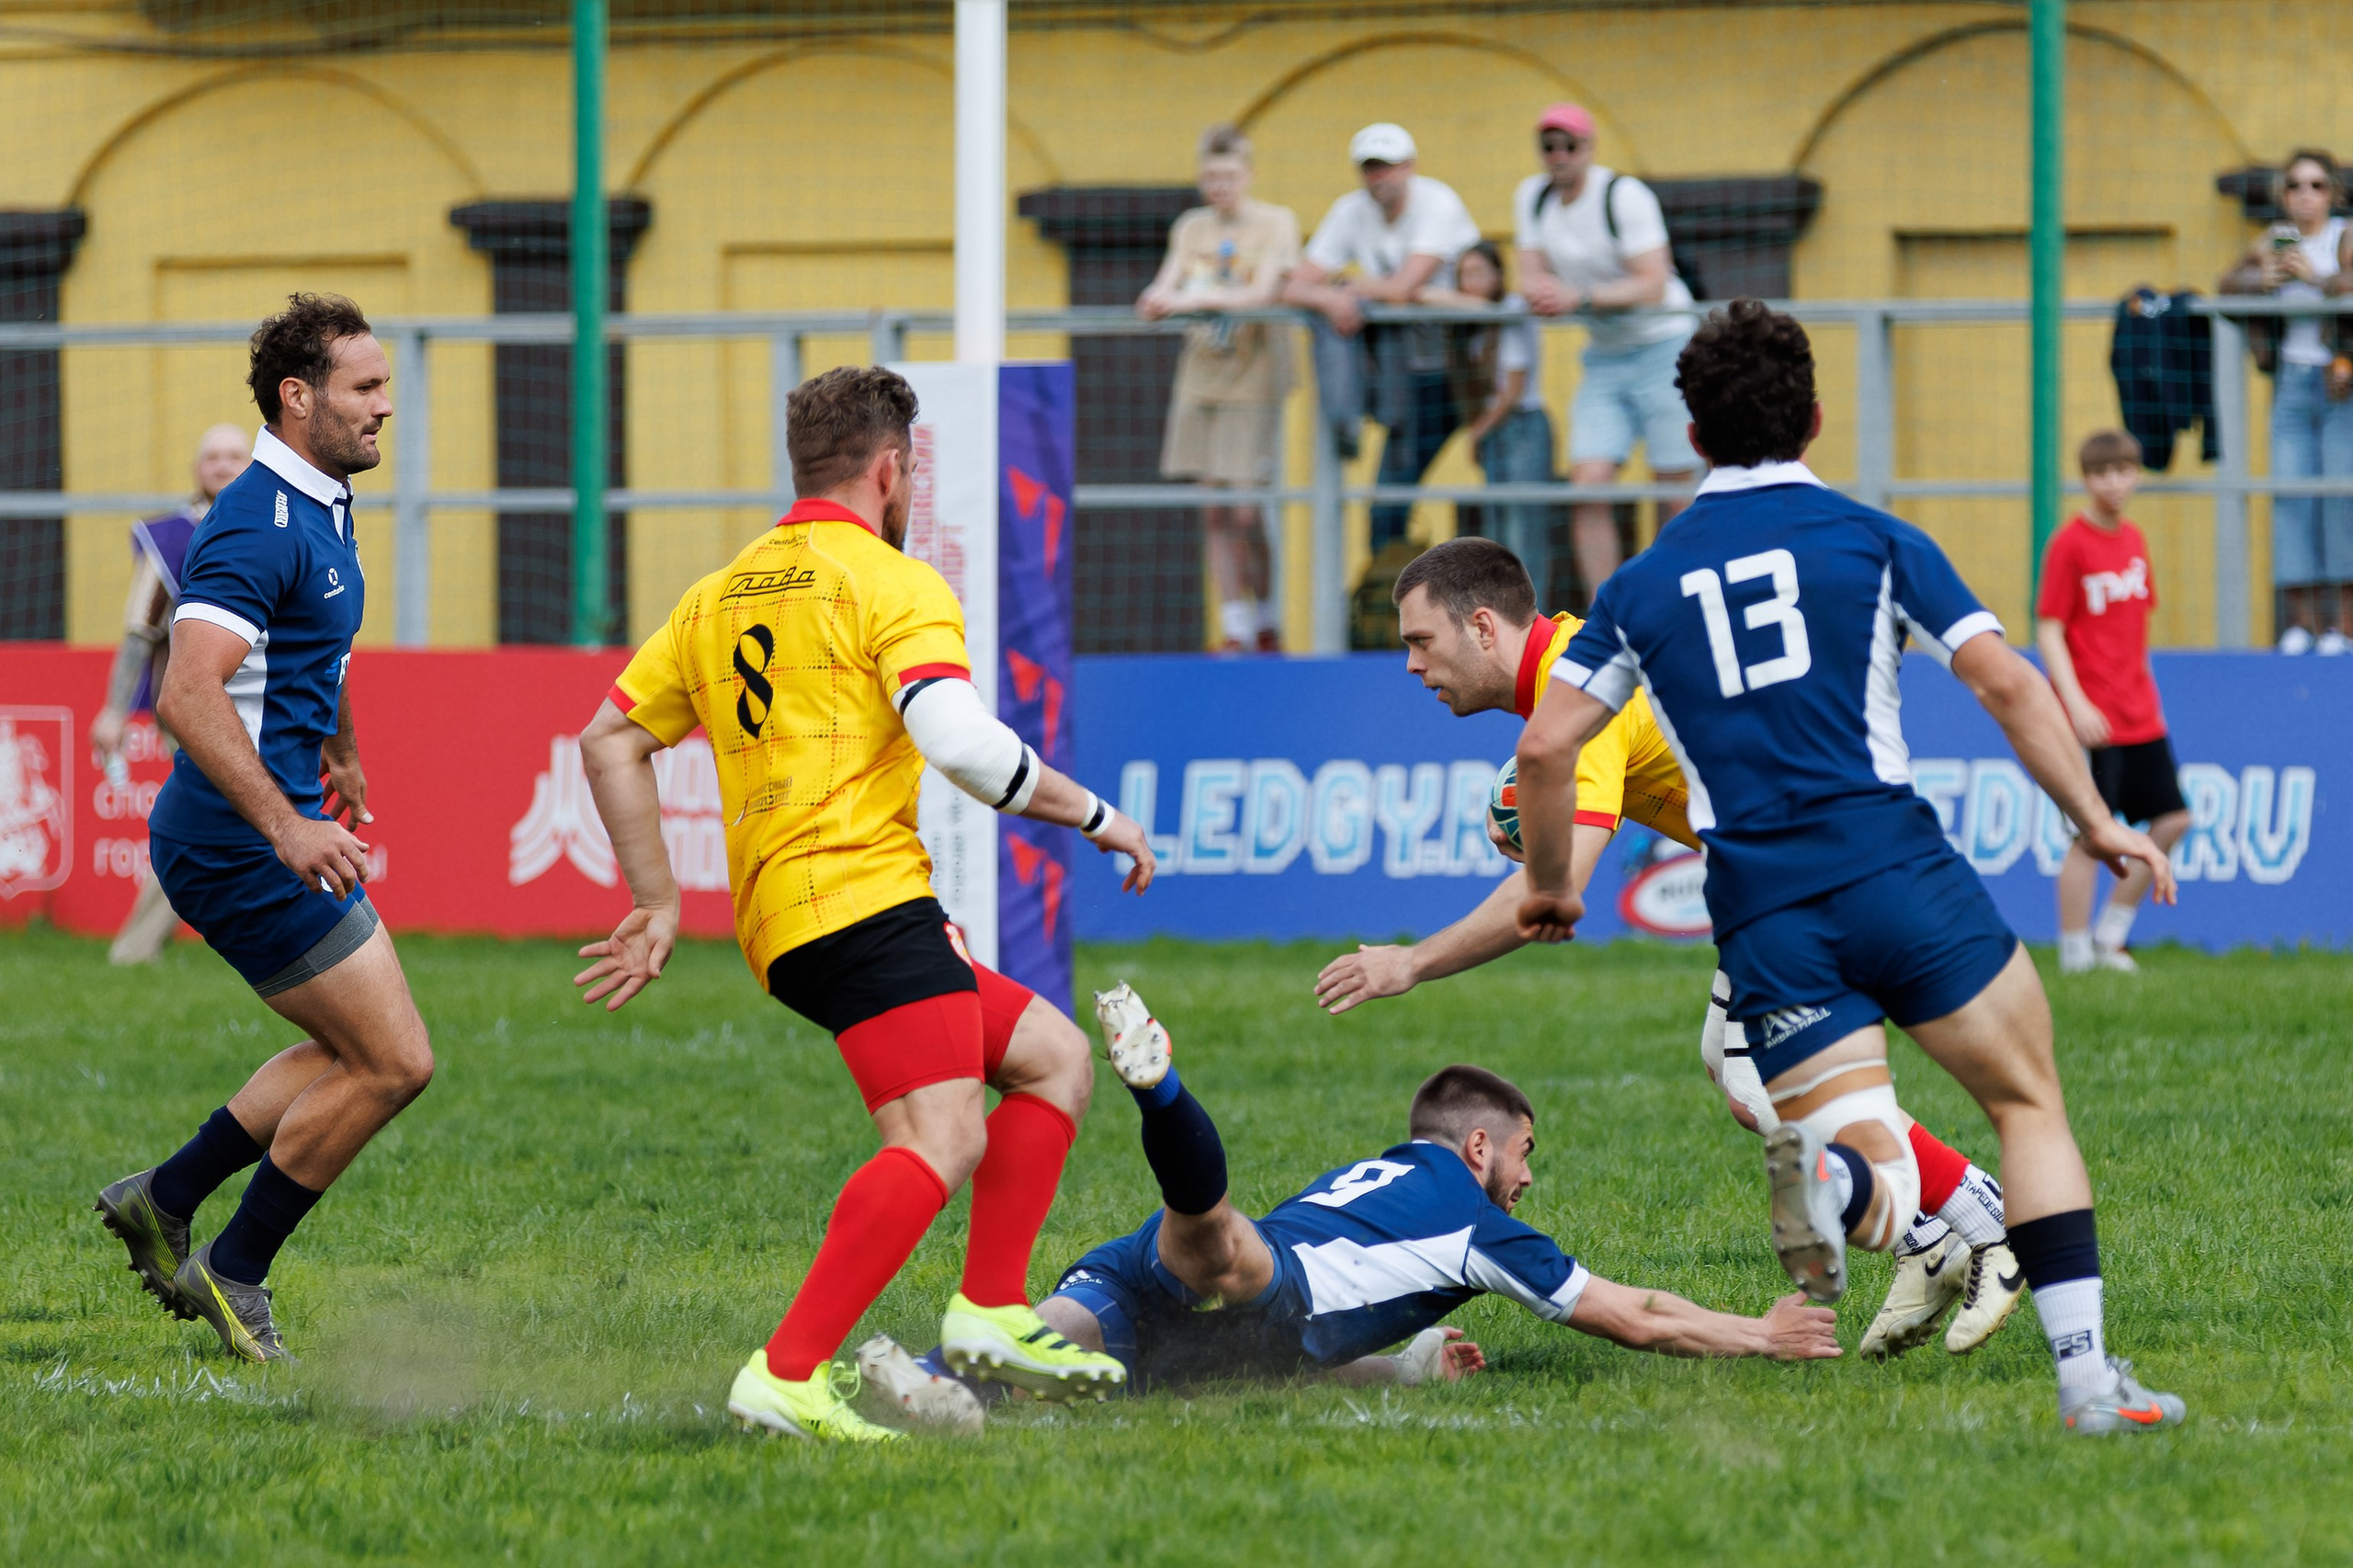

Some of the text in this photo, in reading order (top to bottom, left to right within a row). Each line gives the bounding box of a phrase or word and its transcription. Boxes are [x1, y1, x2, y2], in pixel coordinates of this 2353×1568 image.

[733, 623, 774, 739] 8
[1679, 548, 1812, 699] 13
[1113, 756, 1517, 880] LEDGY.R
[1298, 1160, 1415, 1208] 9
